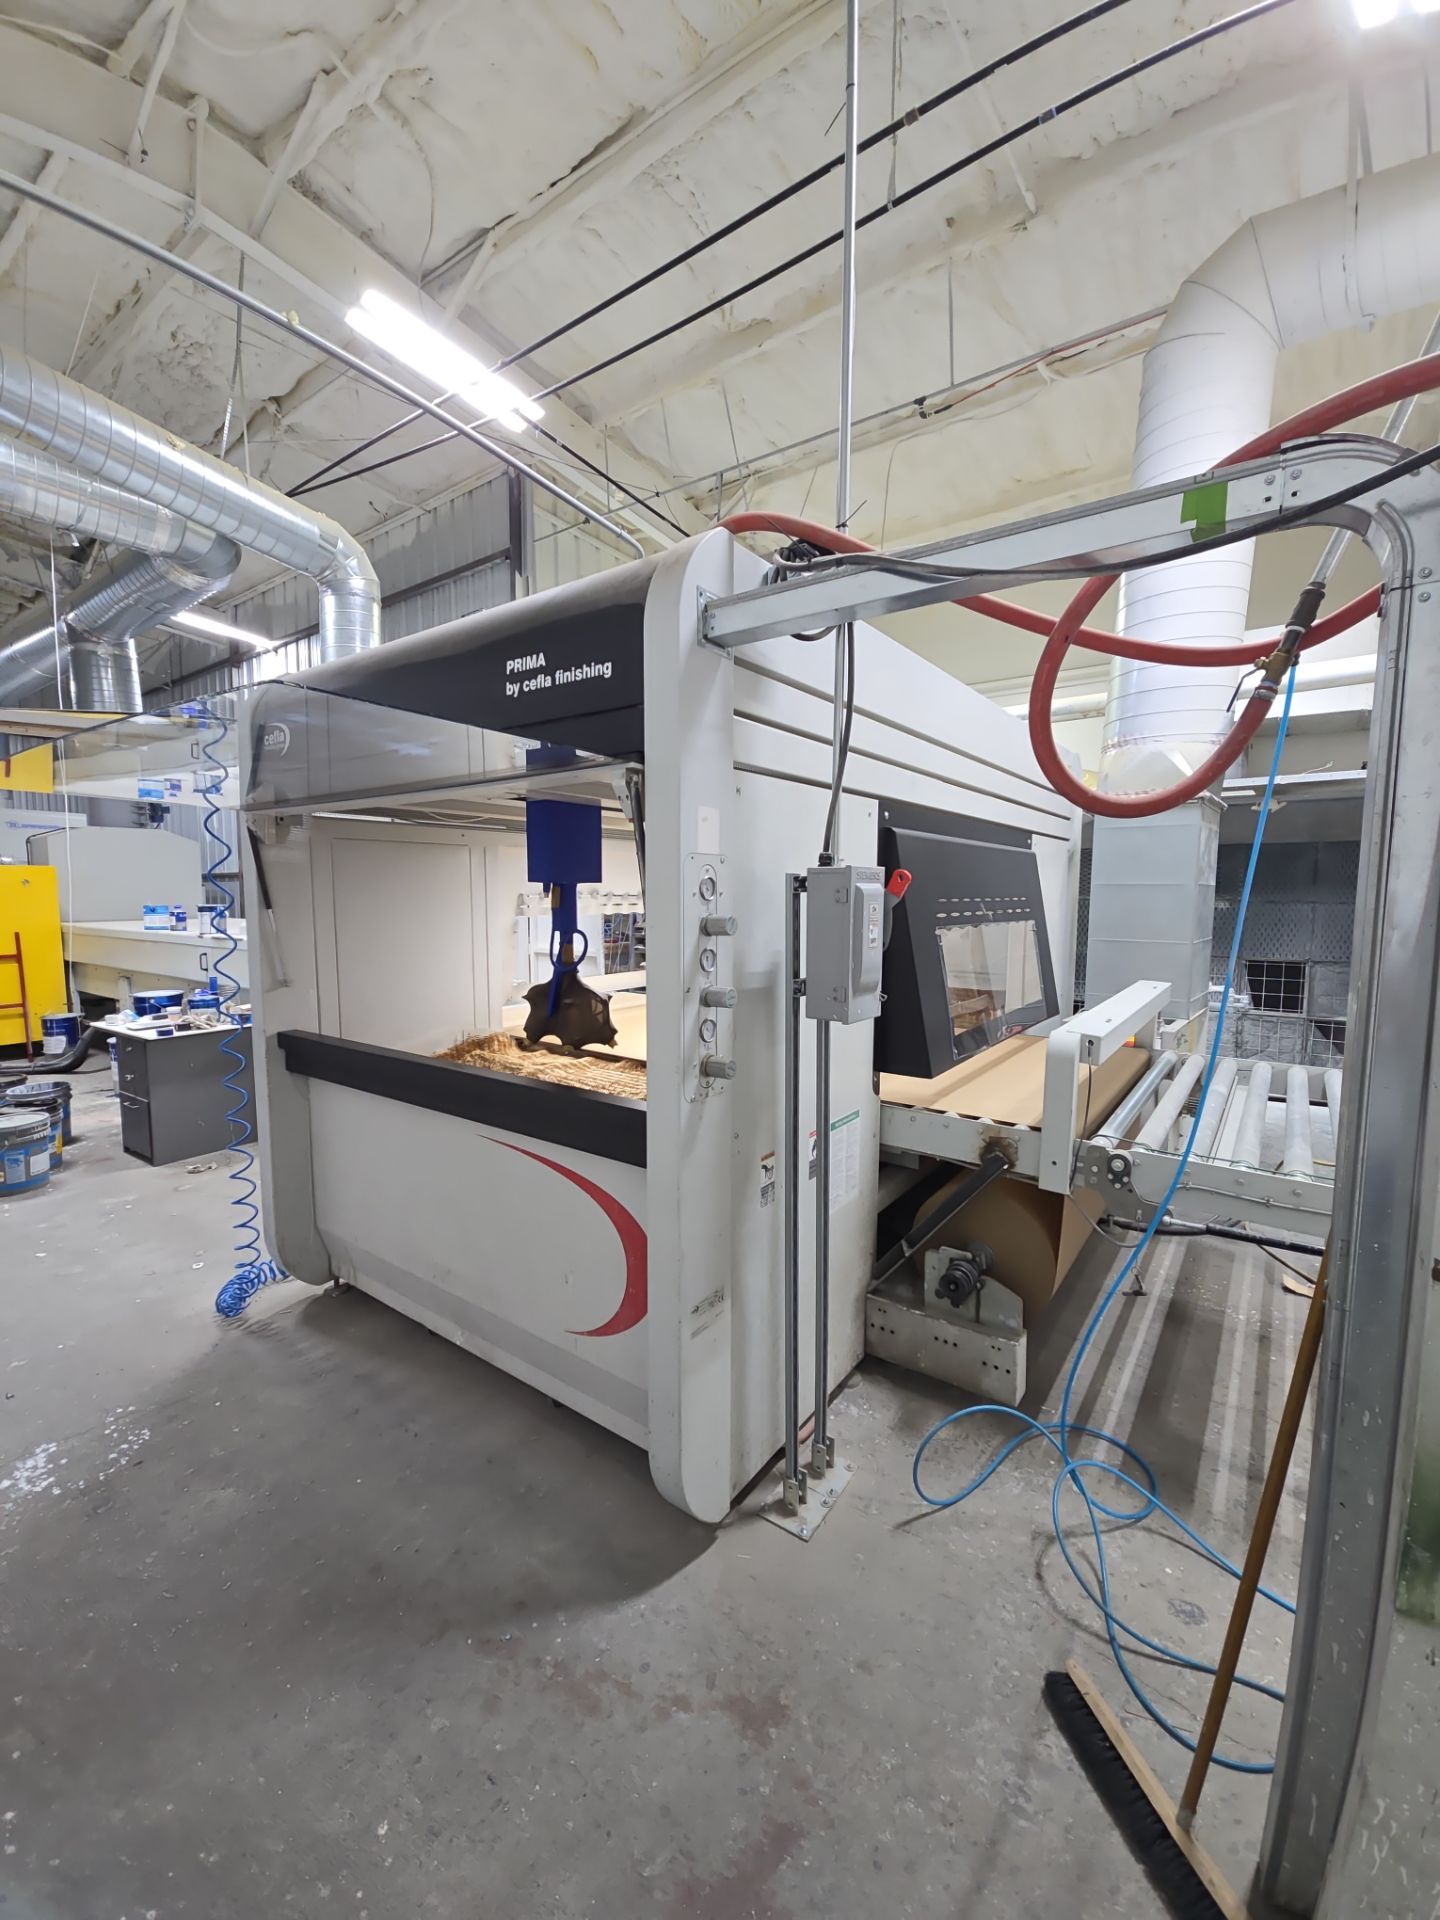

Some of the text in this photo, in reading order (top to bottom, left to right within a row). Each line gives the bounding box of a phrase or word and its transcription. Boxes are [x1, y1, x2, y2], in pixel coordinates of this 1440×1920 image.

[506, 652, 546, 675] PRIMA
[506, 661, 612, 698] by cefla finishing
[264, 729, 285, 745] cefla
